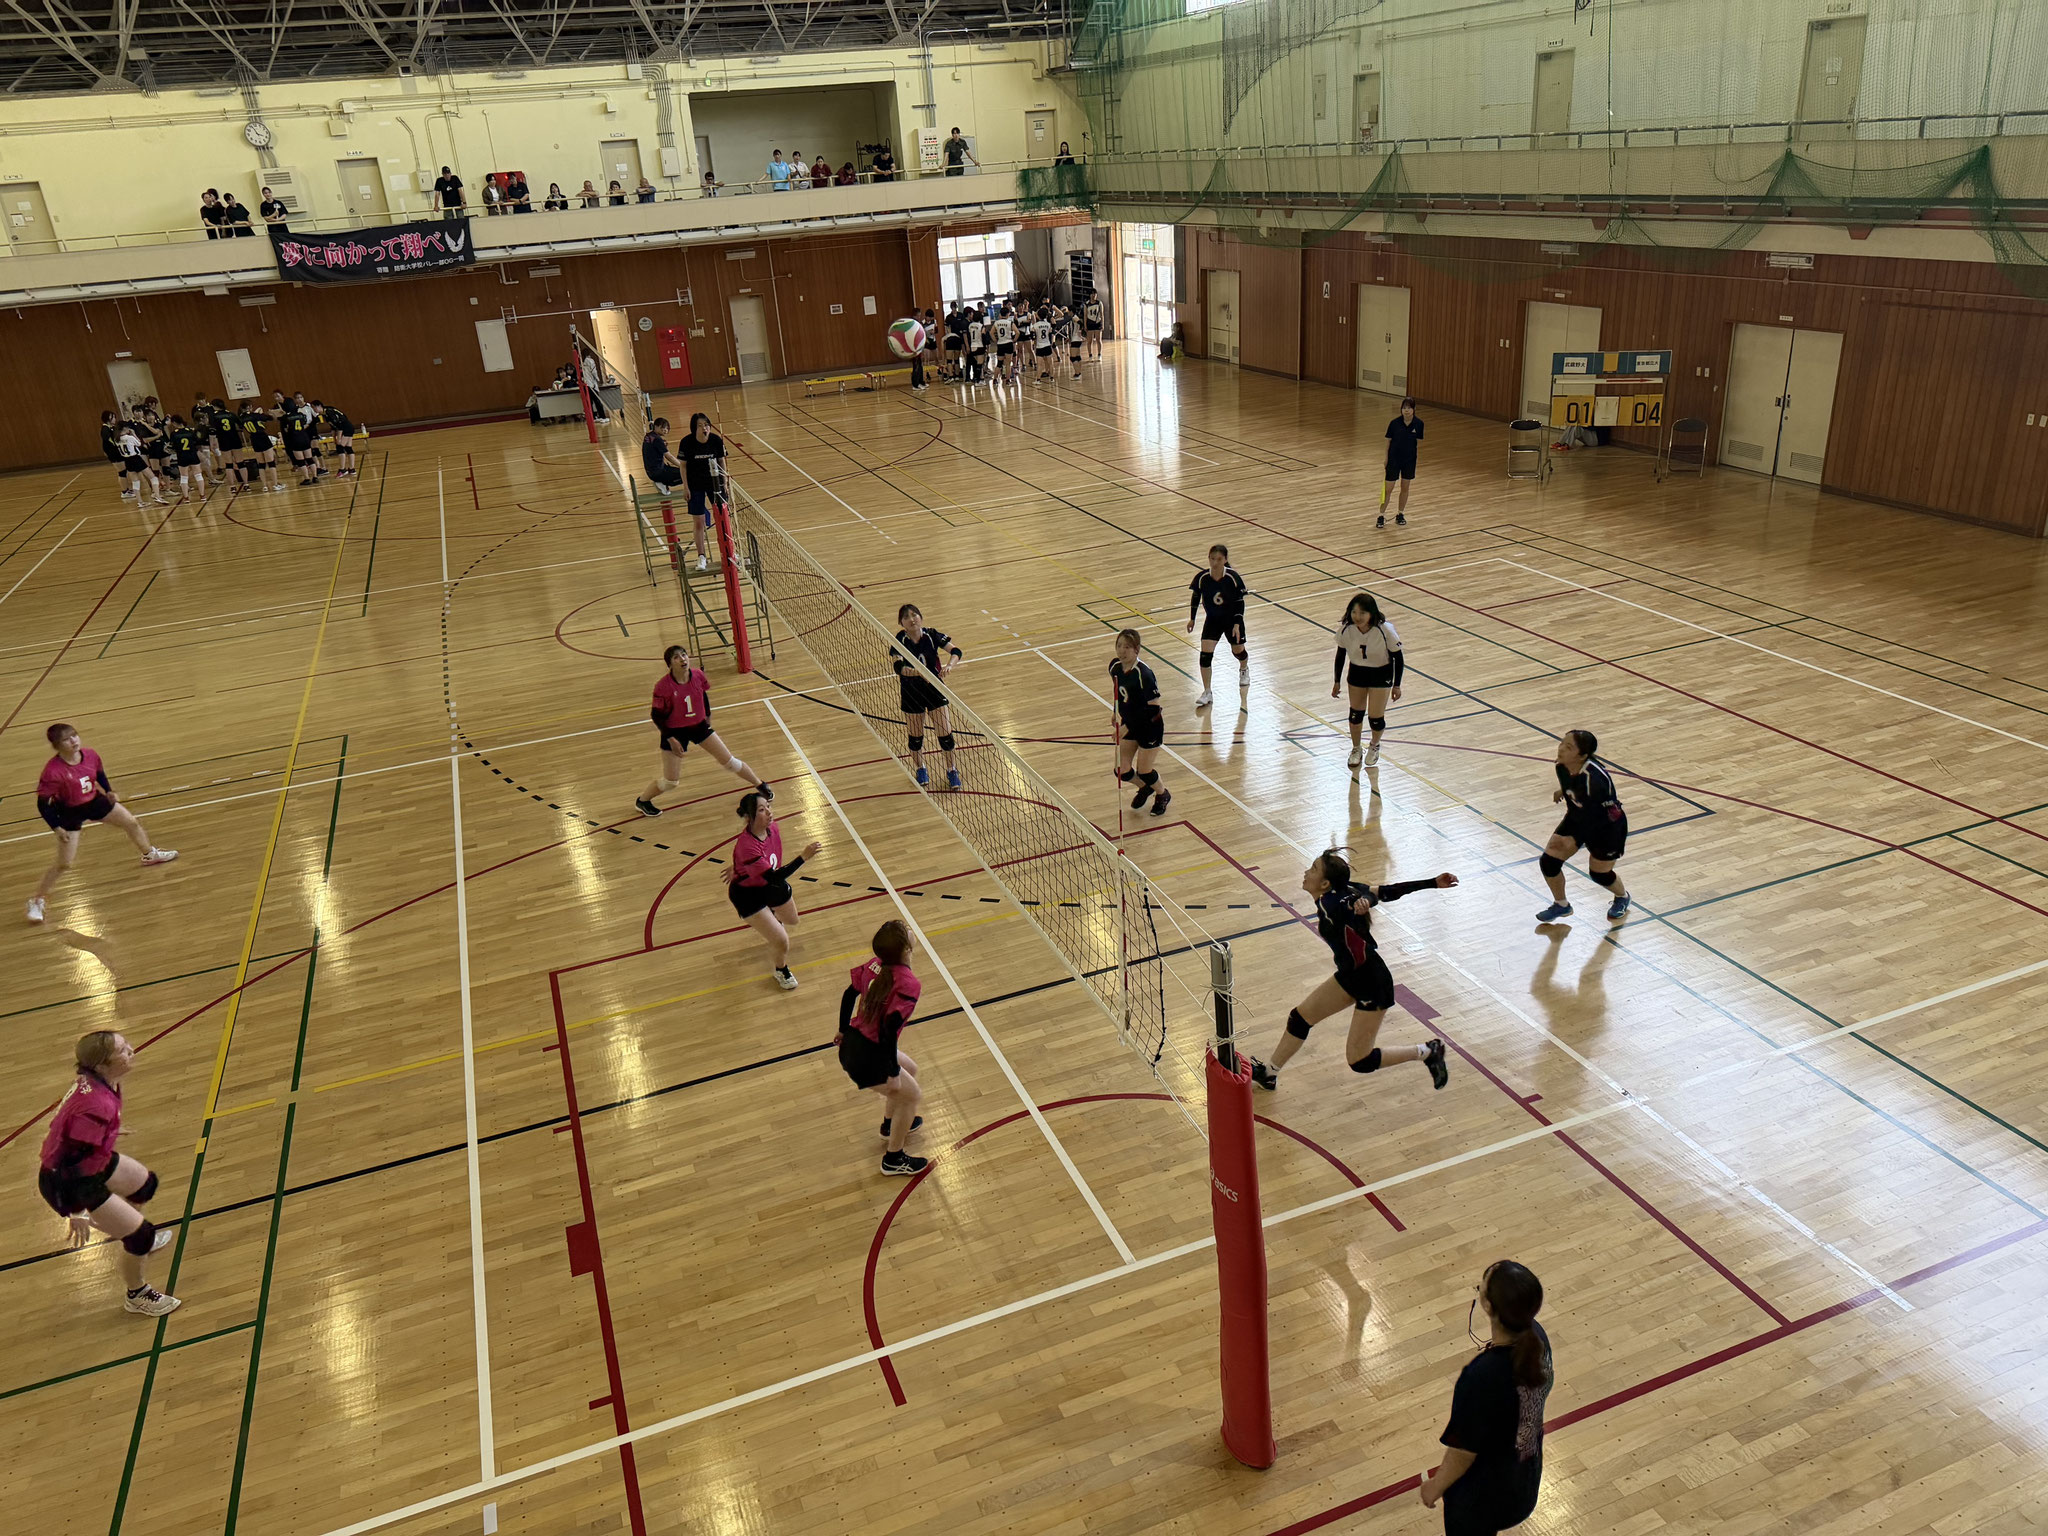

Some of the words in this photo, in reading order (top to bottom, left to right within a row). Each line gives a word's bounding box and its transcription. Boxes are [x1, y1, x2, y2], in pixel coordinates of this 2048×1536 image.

[279, 230, 445, 269] 夢に向かって翔べ
[1323, 283, 1330, 297] A
[1567, 402, 1590, 424] 01
[1634, 401, 1660, 424] 04
[221, 418, 231, 431] 3
[243, 421, 257, 433] 10
[295, 419, 302, 431] 4
[181, 438, 190, 451] 2
[1213, 591, 1224, 606] 6
[1119, 685, 1129, 703] 9
[684, 695, 693, 713] 1
[79, 775, 93, 794] 5
[1214, 1177, 1239, 1203] asics
